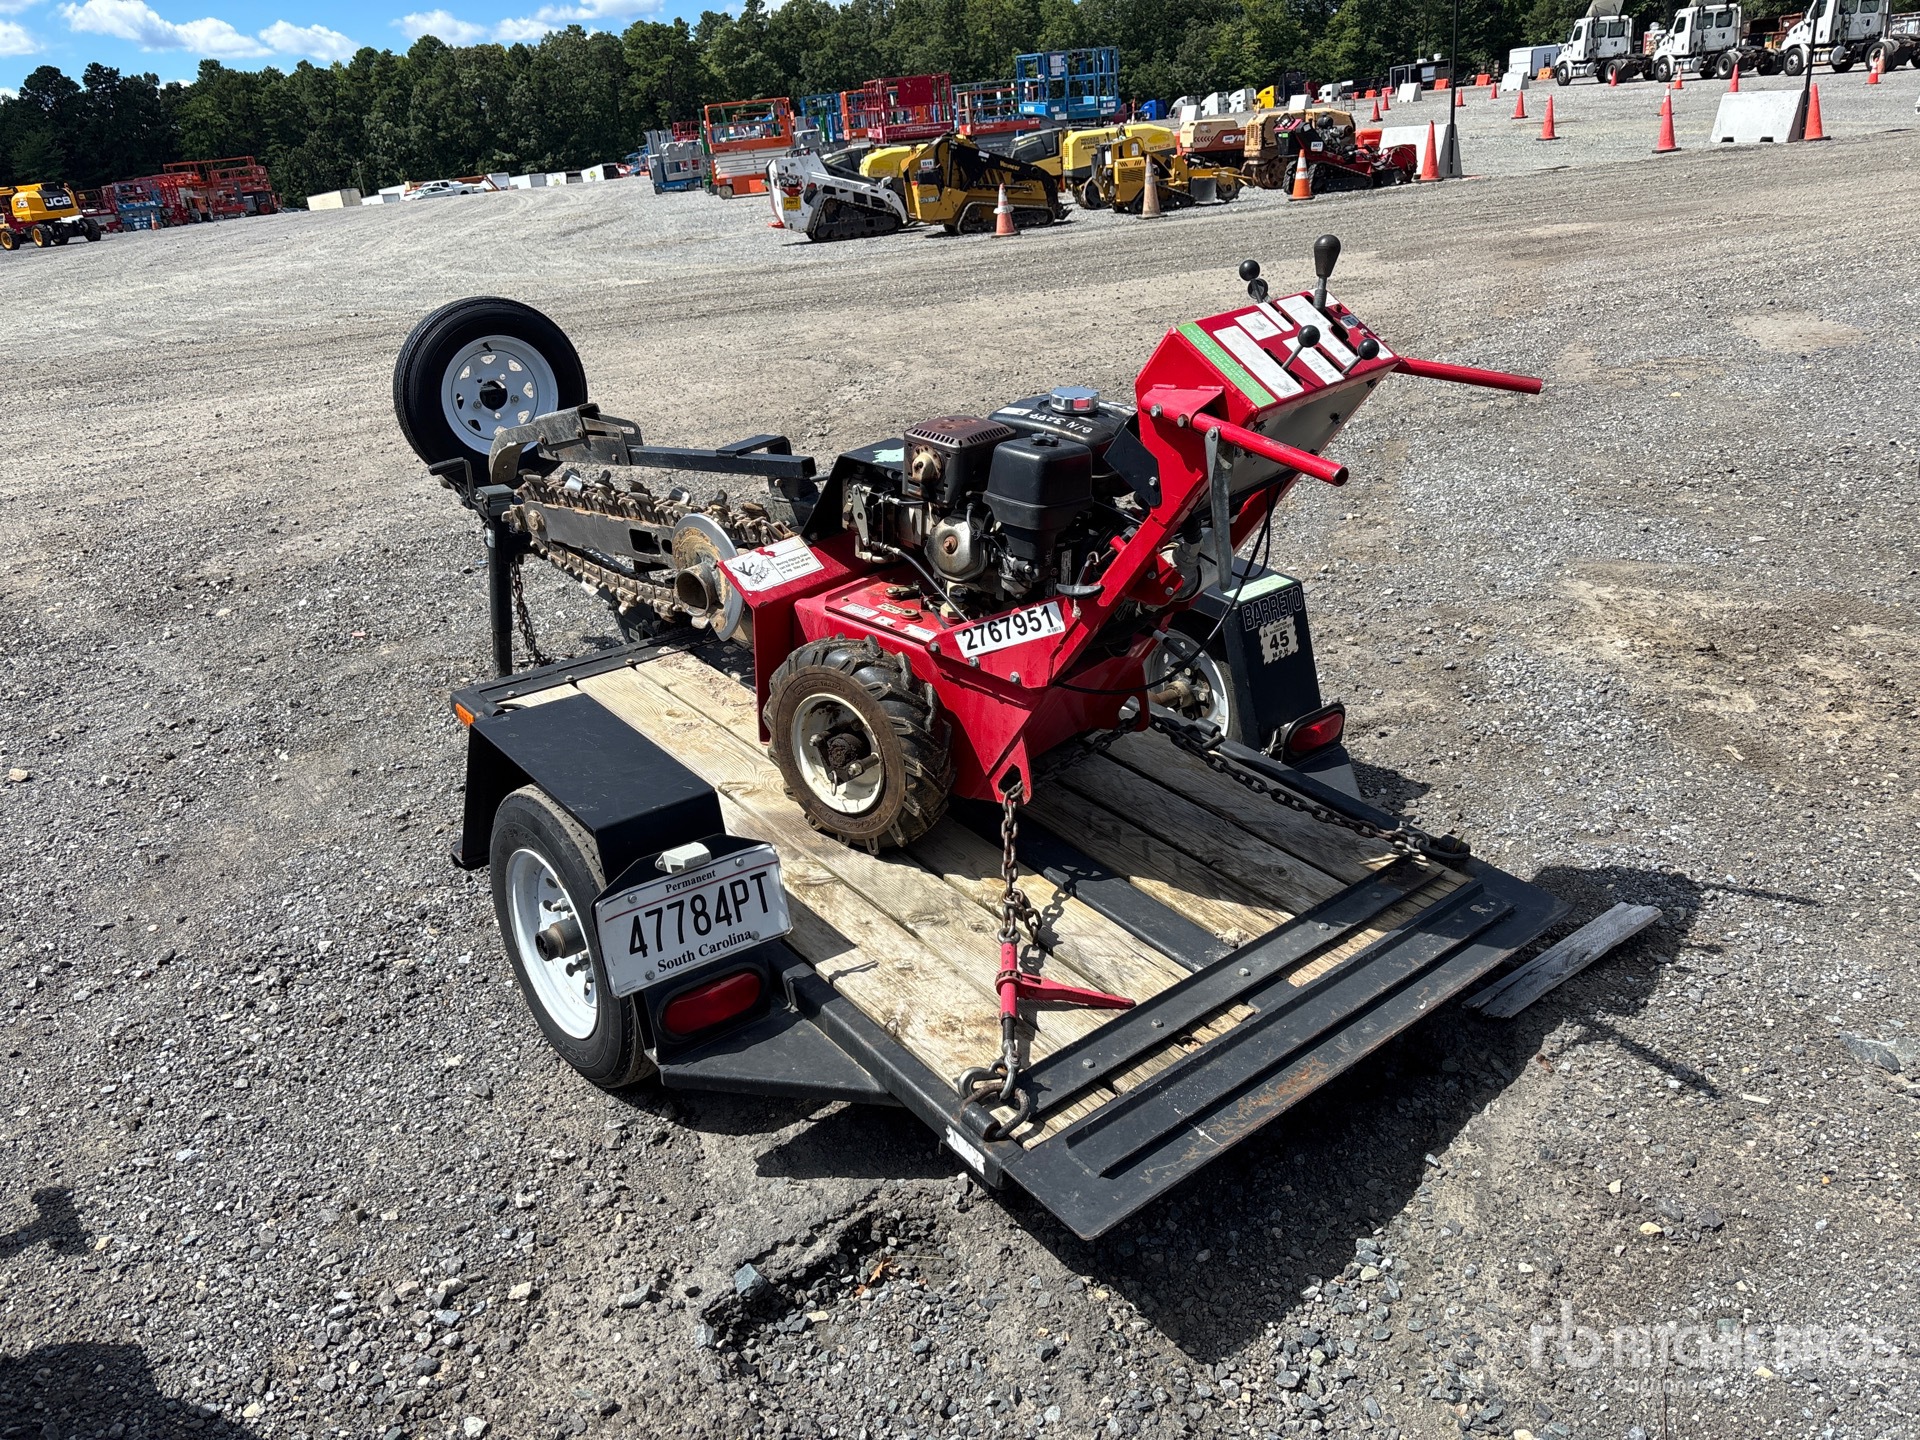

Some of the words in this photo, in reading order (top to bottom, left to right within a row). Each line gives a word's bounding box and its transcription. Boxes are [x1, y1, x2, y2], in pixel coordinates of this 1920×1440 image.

[46, 196, 72, 207] JCB
[962, 605, 1054, 651] 2767951
[1242, 585, 1304, 632] BARRETO
[1270, 630, 1290, 650] 45
[665, 869, 716, 894] Permanent
[629, 871, 767, 958] 47784PT
[658, 949, 695, 973] South
[698, 930, 752, 958] Carolina
